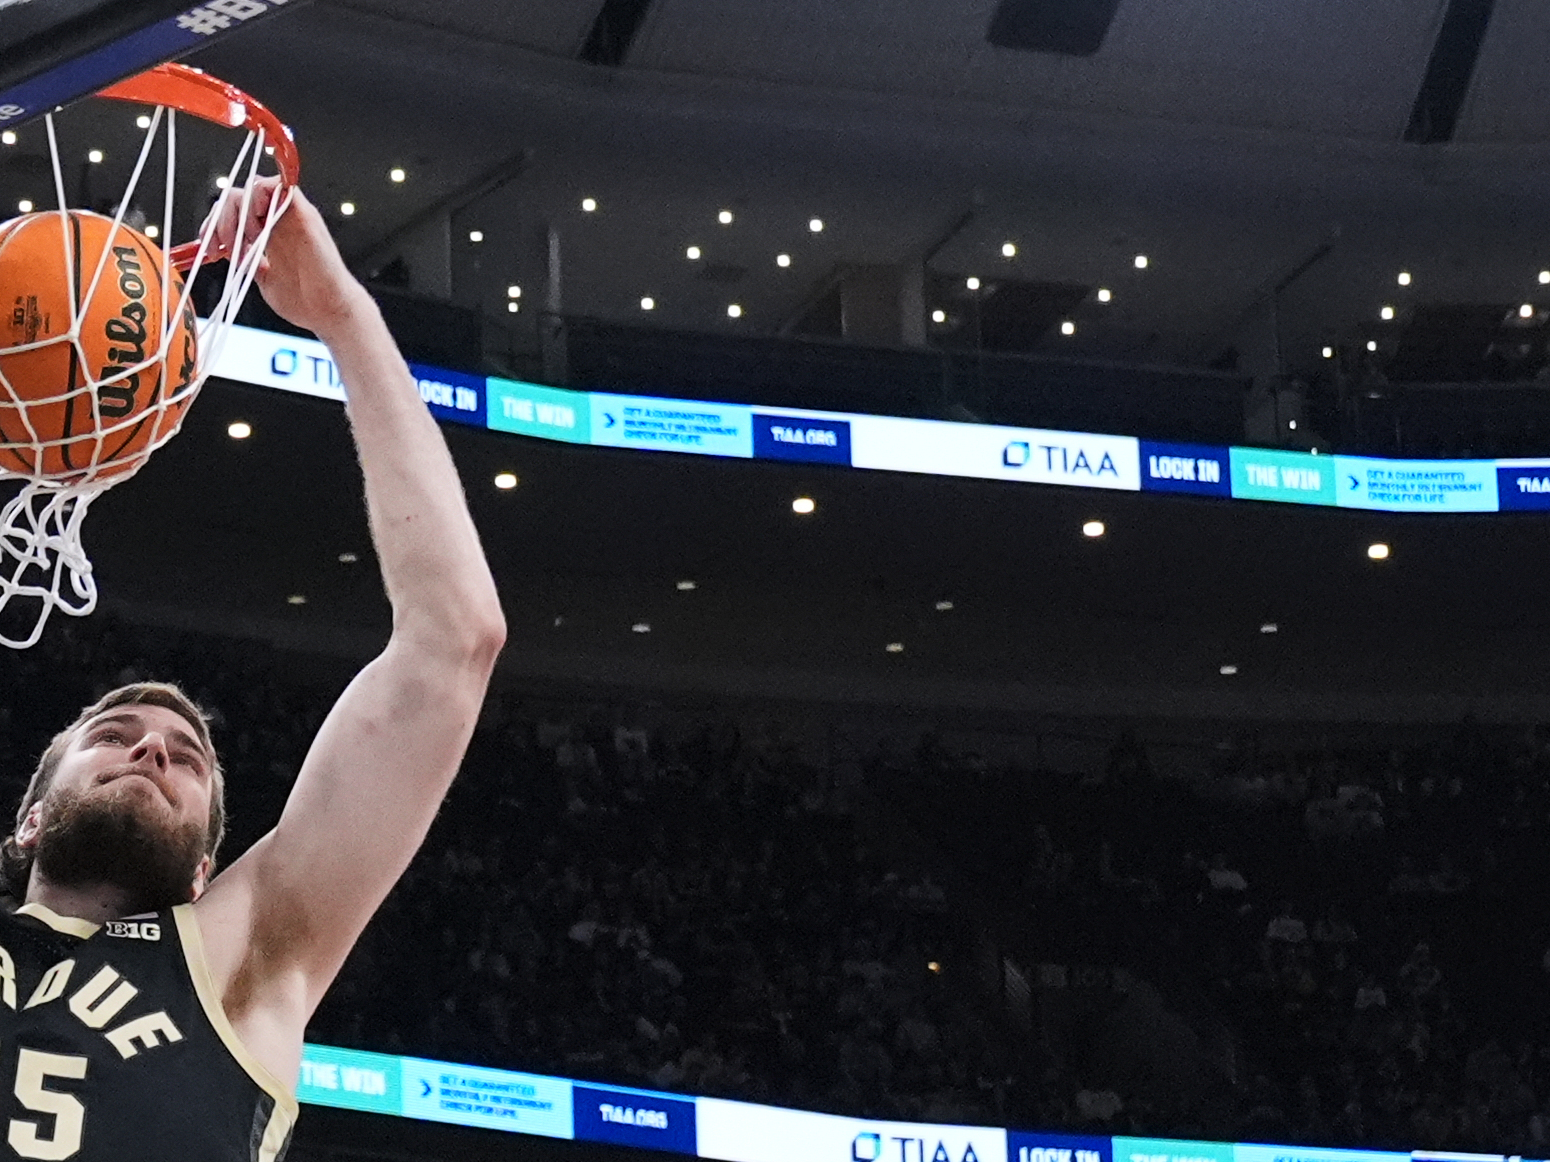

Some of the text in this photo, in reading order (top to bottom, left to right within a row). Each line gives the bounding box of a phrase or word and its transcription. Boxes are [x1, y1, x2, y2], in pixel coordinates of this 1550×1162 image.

[91, 246, 148, 420] Wilson
[306, 356, 342, 388] TI
[417, 378, 478, 411] OCK IN
[502, 398, 575, 429] THE WIN
[1038, 444, 1119, 477] TIAA
[1150, 455, 1220, 483] LOCK IN
[1246, 463, 1321, 491] THE WIN
[301, 1060, 387, 1097] THE WIN
